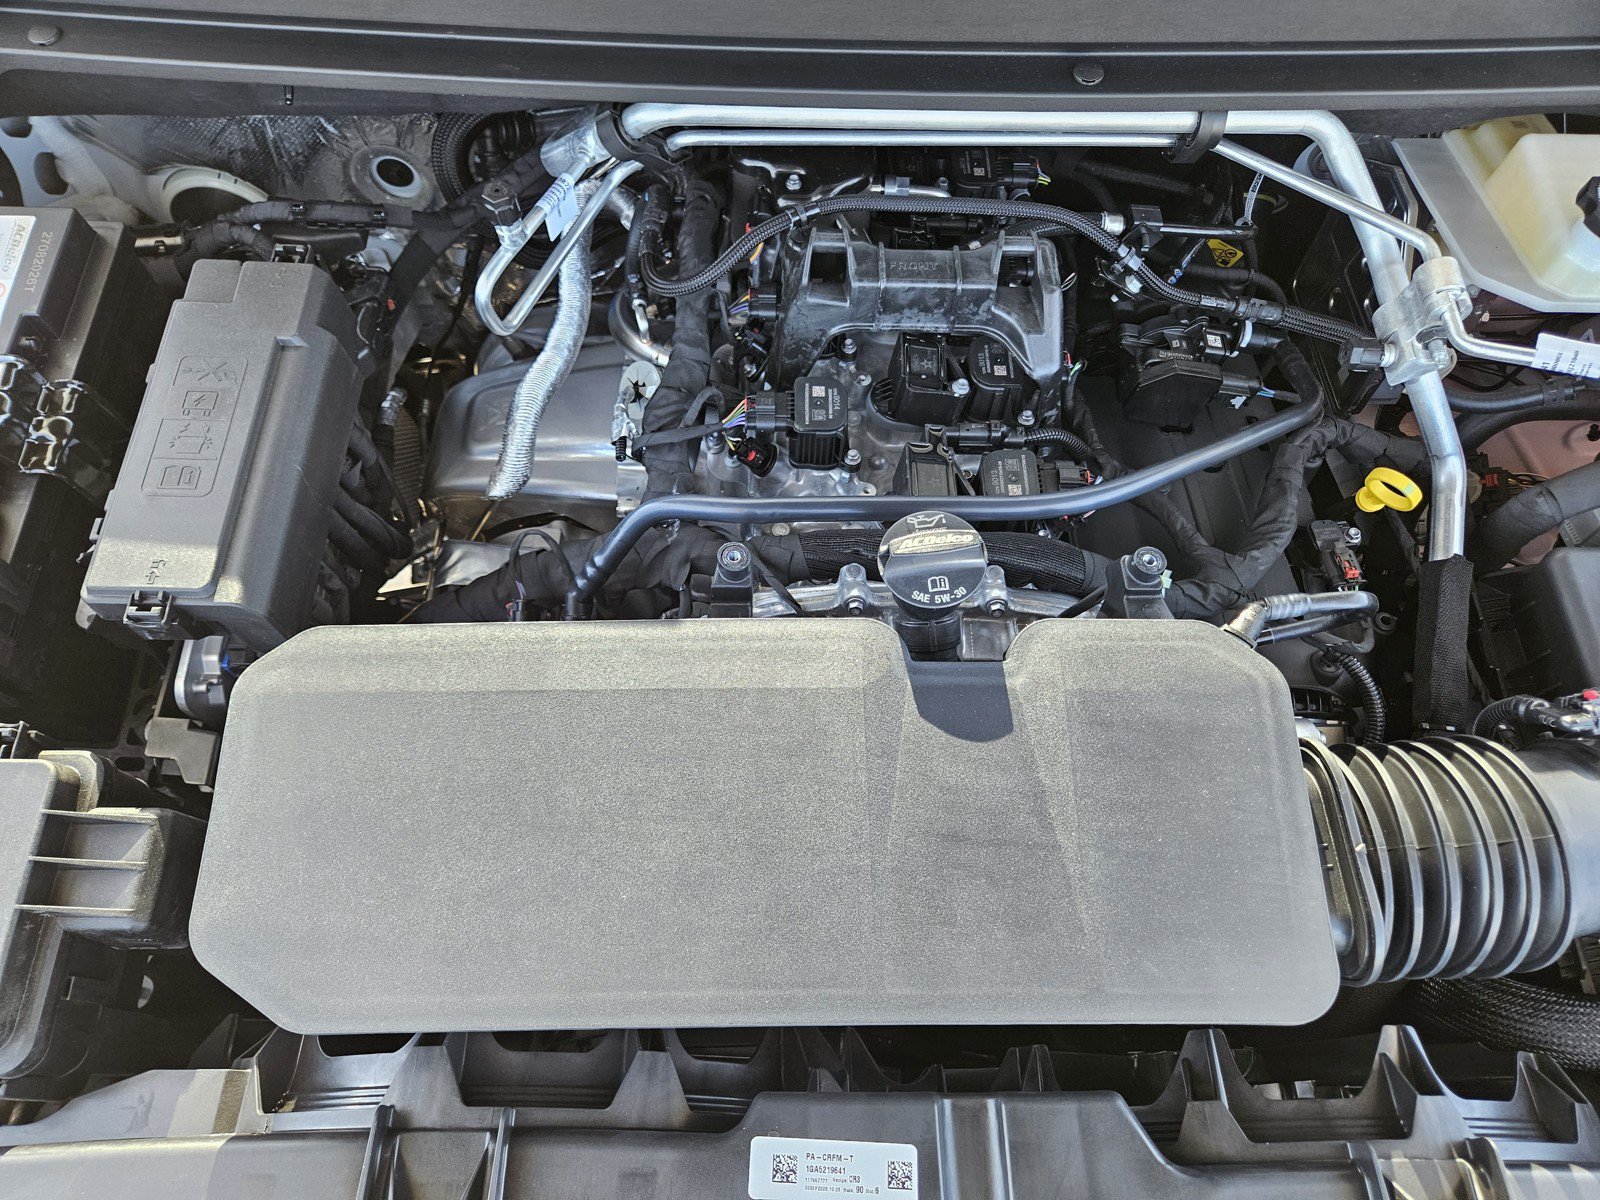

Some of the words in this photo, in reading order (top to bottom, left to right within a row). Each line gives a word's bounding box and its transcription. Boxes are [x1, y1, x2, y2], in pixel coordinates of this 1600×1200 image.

[889, 261, 939, 271] FRONT
[900, 534, 974, 548] ACDelco
[911, 591, 931, 603] SAE
[934, 586, 967, 604] 5W-30
[848, 1175, 860, 1183] CR3
[855, 1186, 864, 1194] 90
